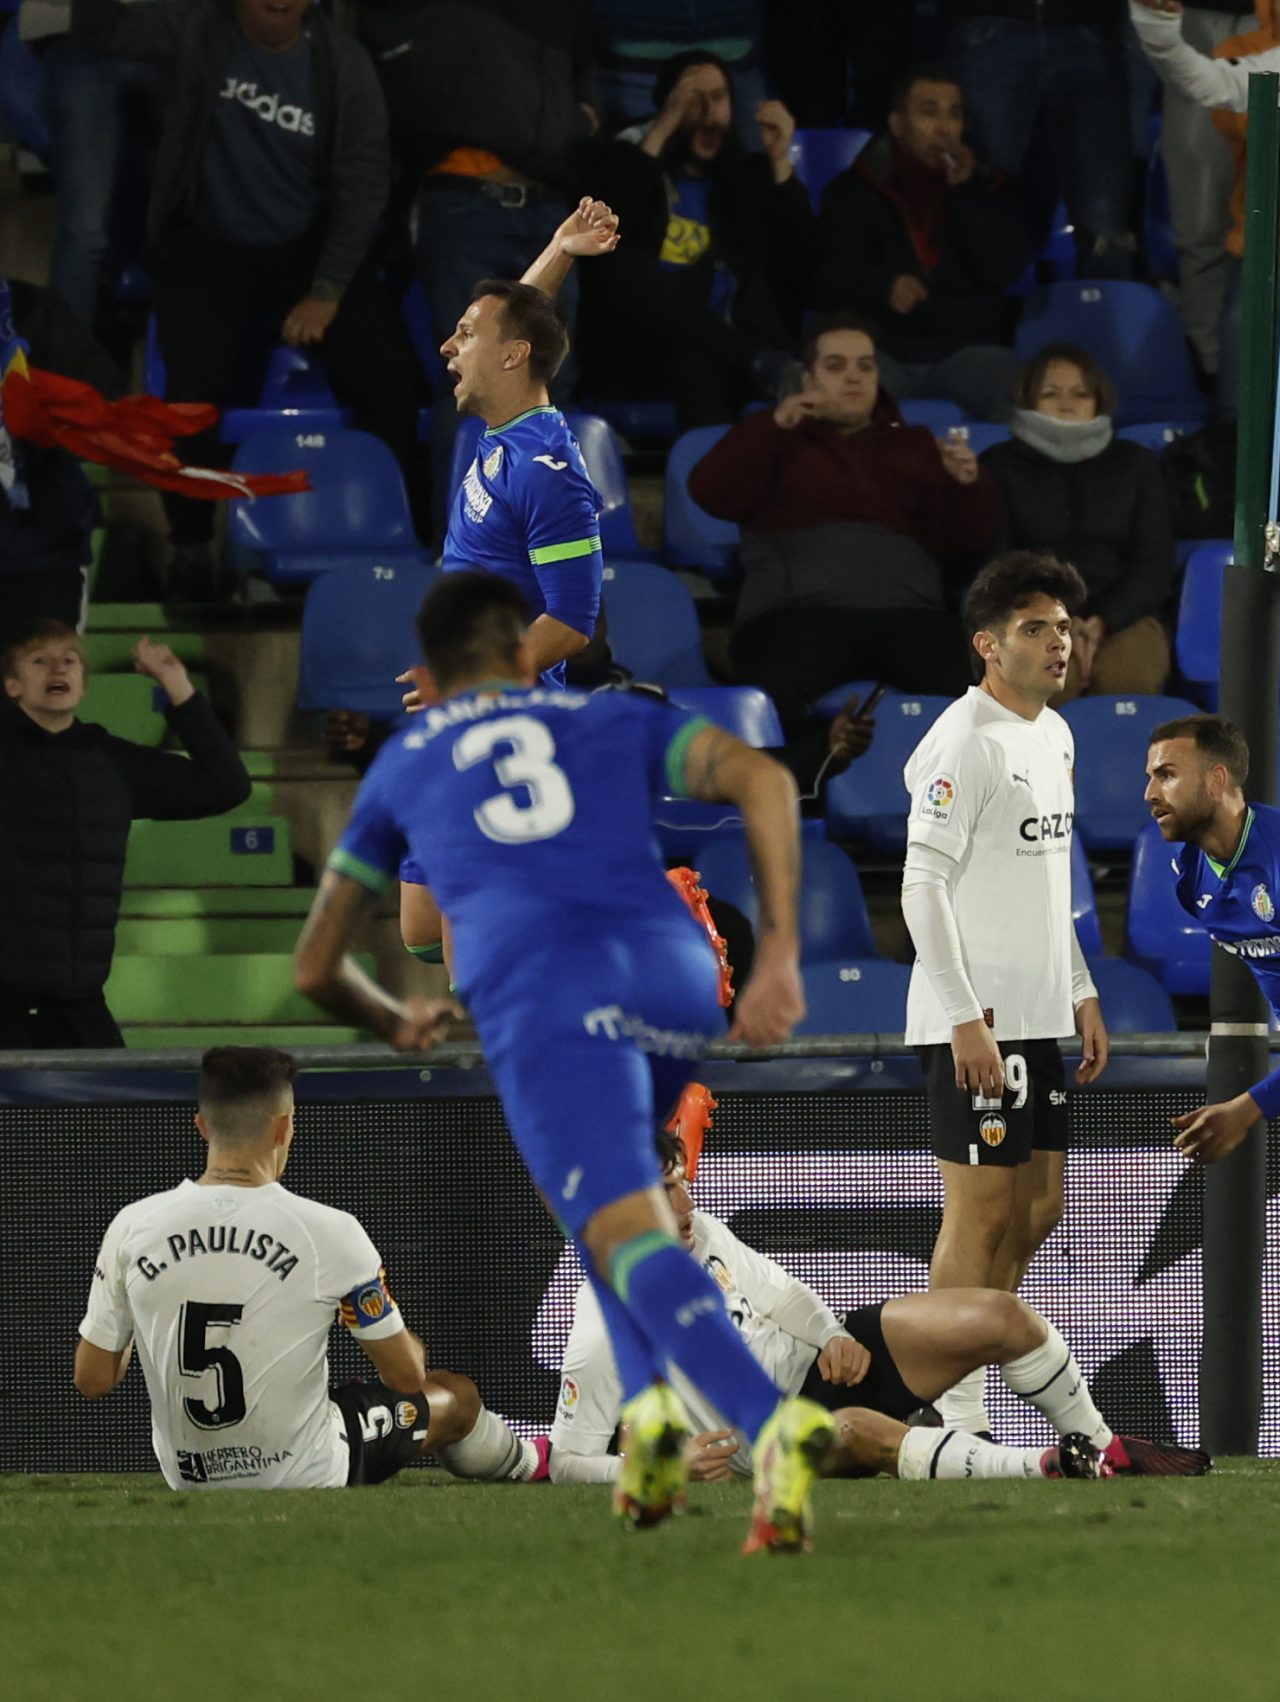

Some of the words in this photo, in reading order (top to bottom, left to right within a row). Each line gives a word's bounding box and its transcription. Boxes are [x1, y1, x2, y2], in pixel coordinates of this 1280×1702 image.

[452, 714, 577, 845] 3
[245, 830, 258, 850] 6
[972, 1053, 1028, 1111] 9
[137, 1256, 168, 1282] G.
[167, 1226, 300, 1282] PAULISTA
[178, 1299, 247, 1432] 5
[357, 1404, 394, 1442] 5
[202, 1446, 262, 1463] HERRERO
